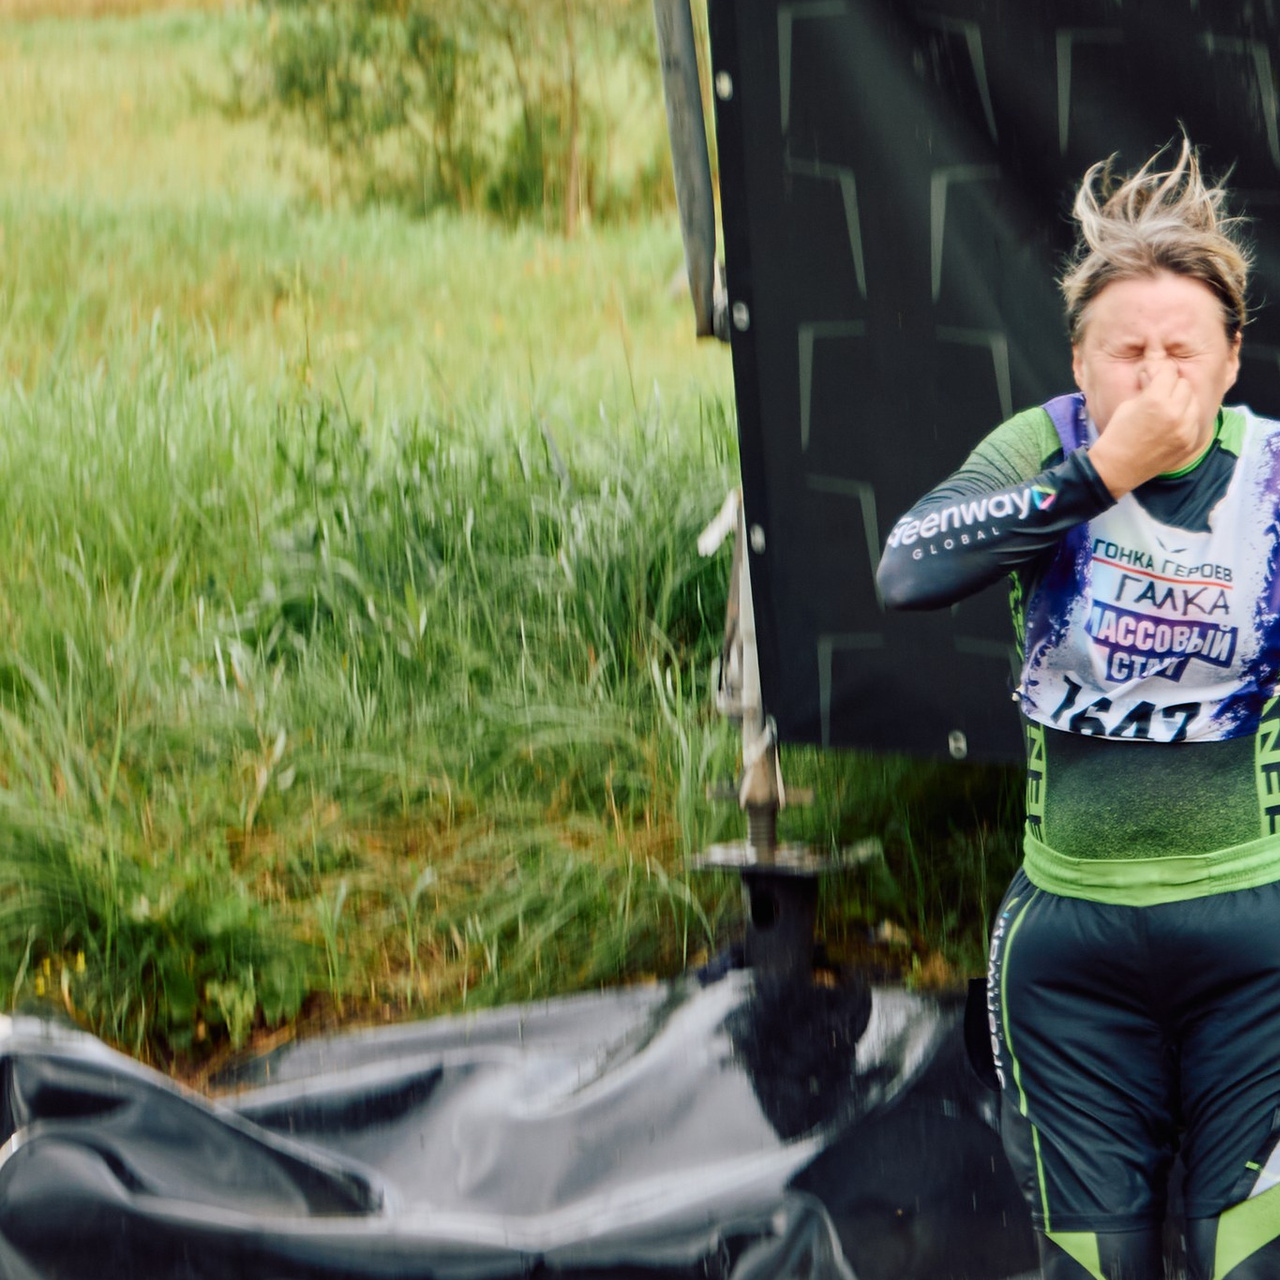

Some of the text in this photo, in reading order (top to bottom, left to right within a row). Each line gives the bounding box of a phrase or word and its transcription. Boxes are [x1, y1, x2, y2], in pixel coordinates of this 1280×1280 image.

[887, 488, 1031, 549] reenway
[911, 526, 1000, 561] GLOBAL
[1092, 538, 1233, 582] ГОНКА ГЕРОЕВ
[1115, 573, 1230, 616] ГАЛКА
[1050, 674, 1202, 742] 1647
